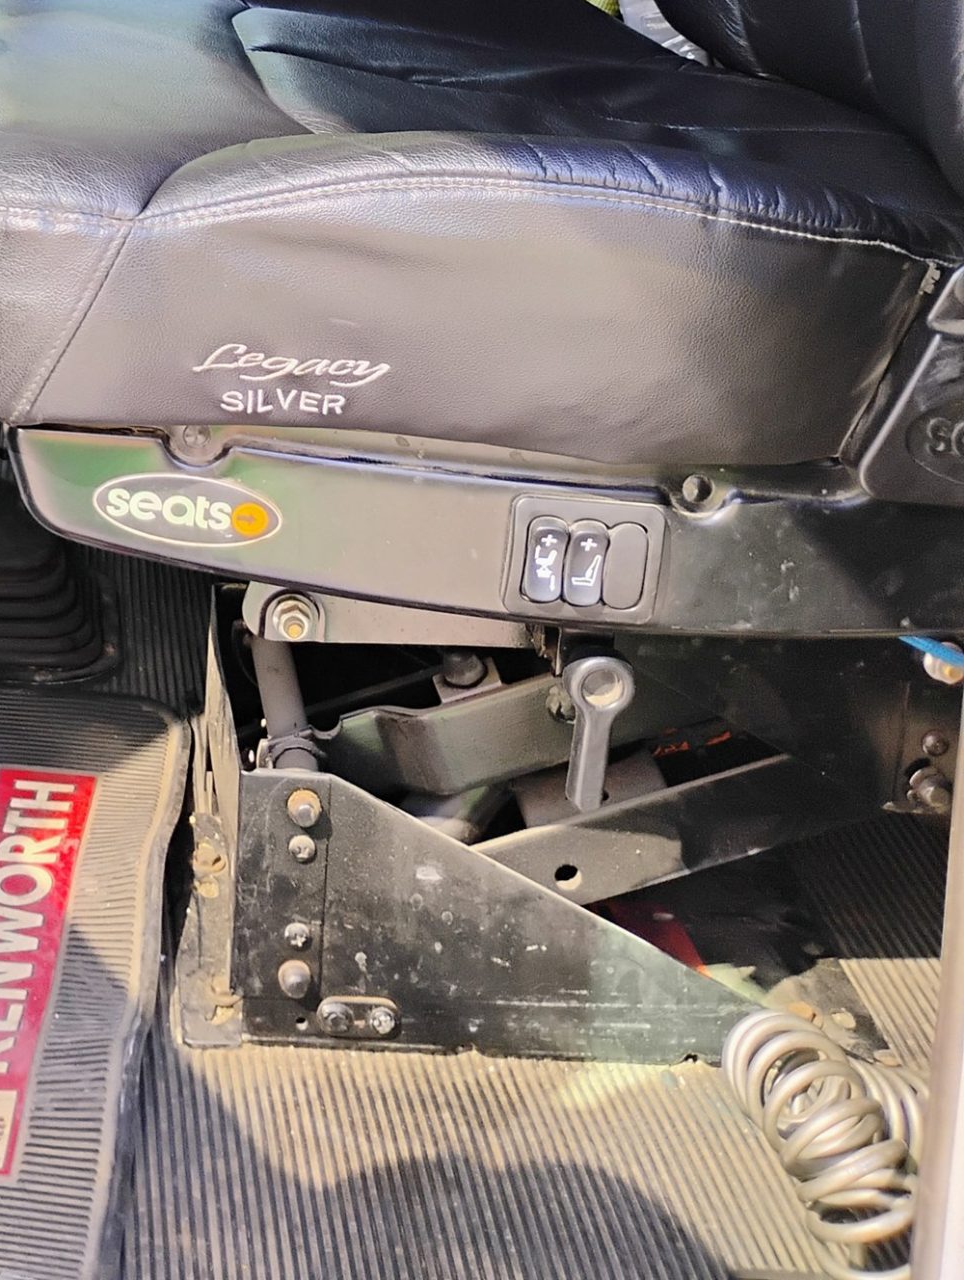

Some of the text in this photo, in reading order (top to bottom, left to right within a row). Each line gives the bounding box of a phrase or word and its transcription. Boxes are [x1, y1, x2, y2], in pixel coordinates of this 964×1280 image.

[193, 343, 390, 387] Legacy
[220, 389, 346, 415] SILVER
[106, 488, 232, 530] seats
